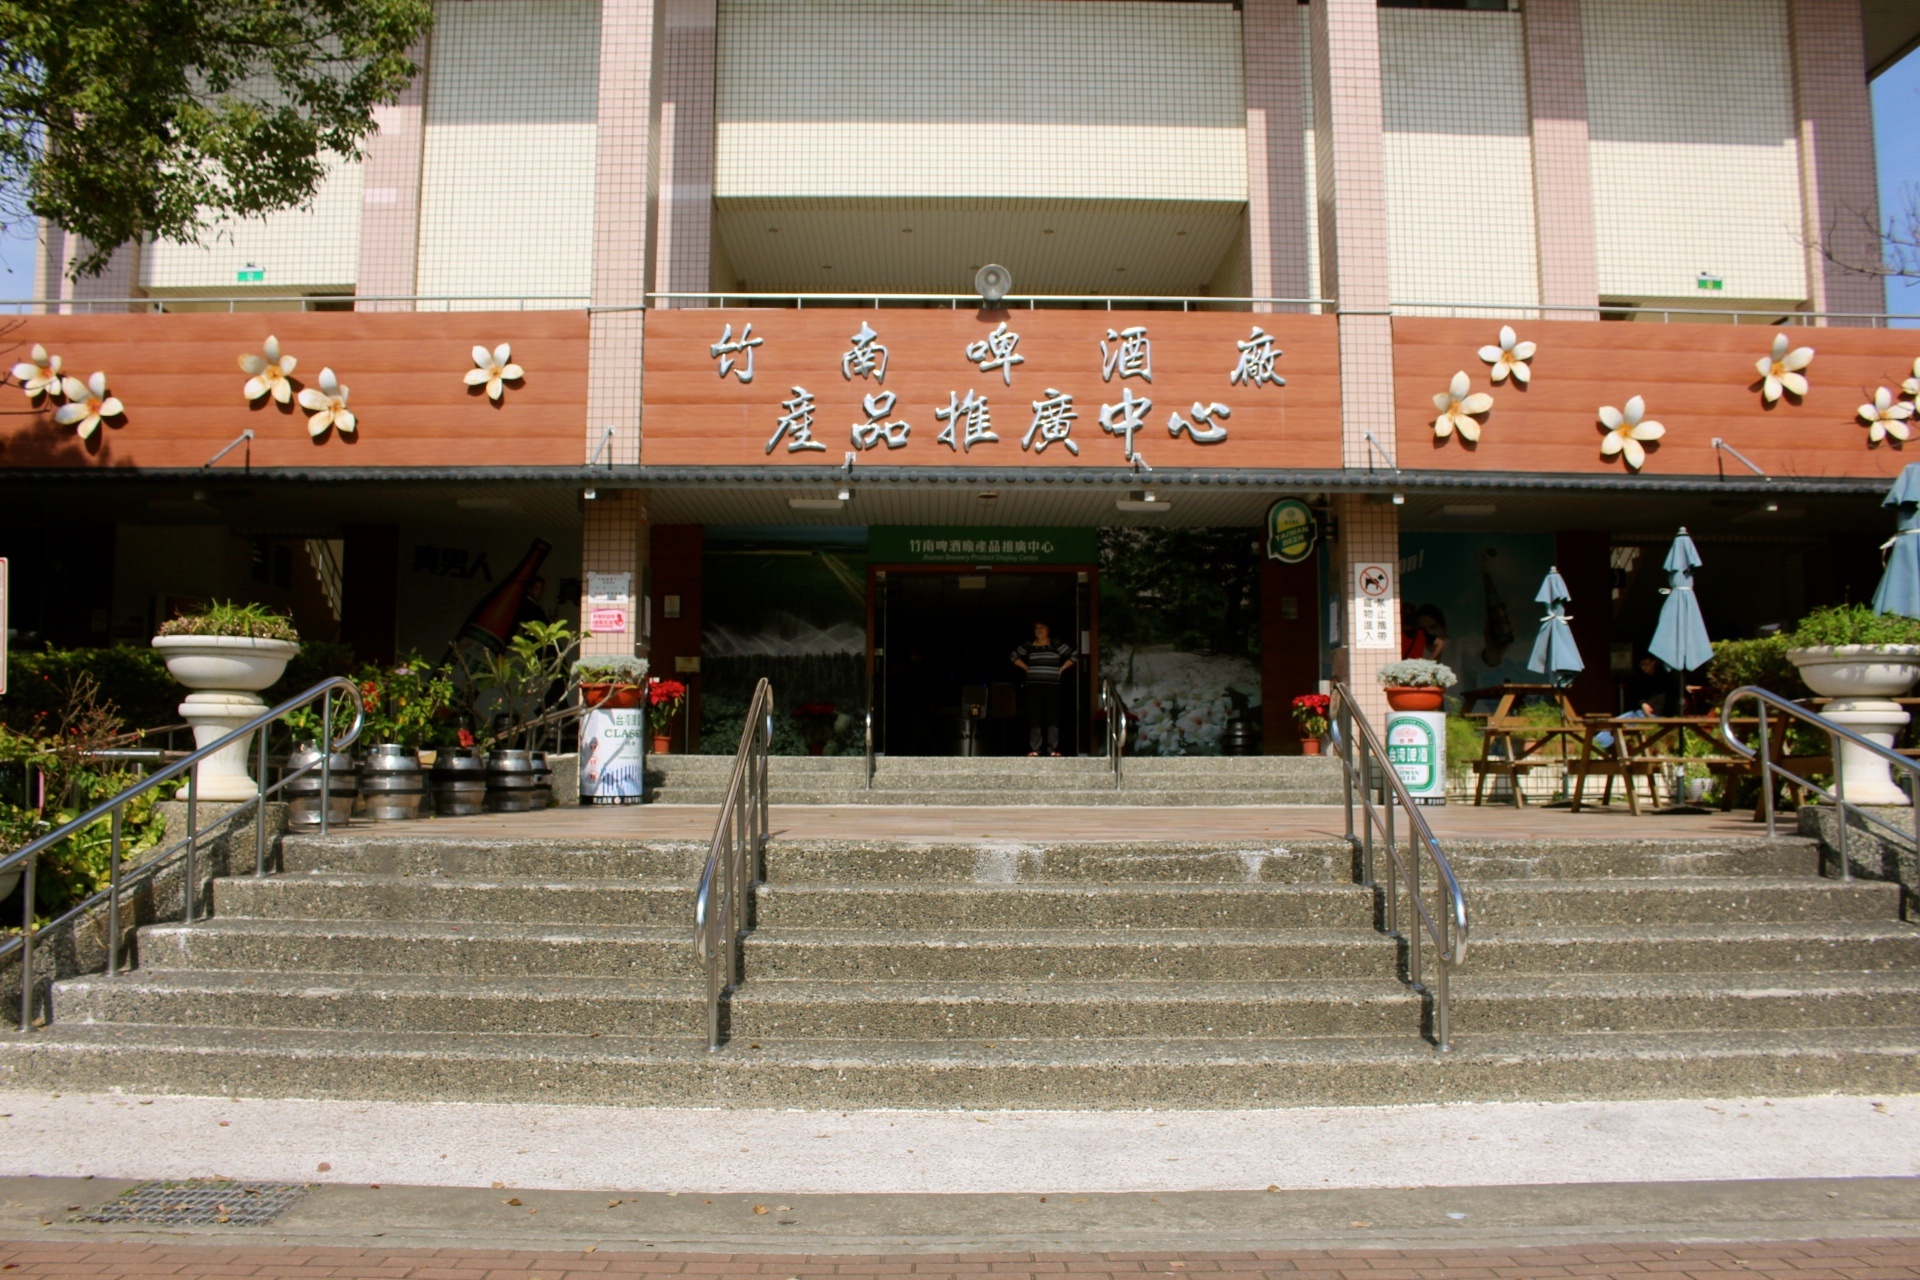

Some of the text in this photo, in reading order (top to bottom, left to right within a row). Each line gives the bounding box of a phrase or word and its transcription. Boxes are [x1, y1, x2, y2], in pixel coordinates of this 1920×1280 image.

[711, 320, 1287, 388] 竹南啤酒廠
[1275, 526, 1309, 542] TAIWAN
[1282, 534, 1305, 547] BEER
[909, 539, 1054, 554] 竹南啤酒廠產品推廣中心
[1376, 597, 1388, 642] 禁止攜帶
